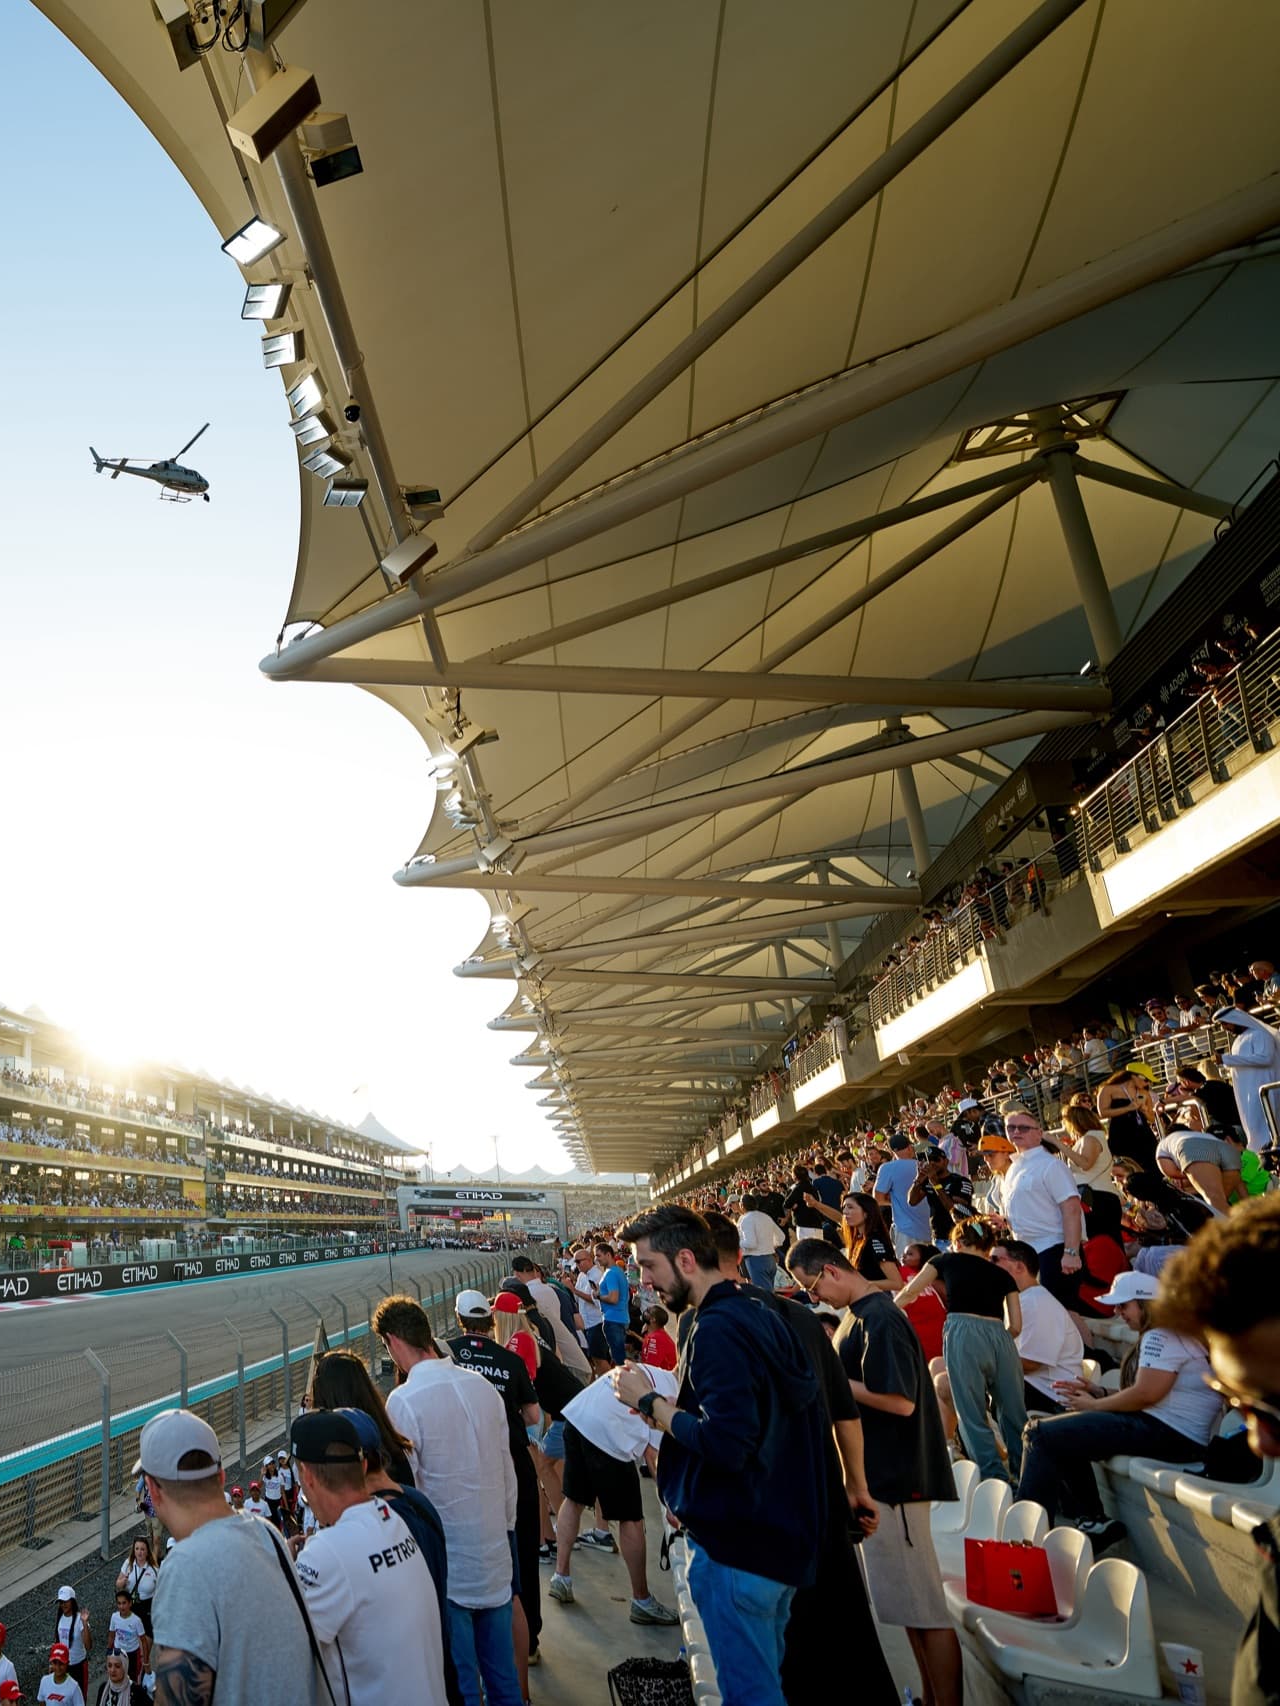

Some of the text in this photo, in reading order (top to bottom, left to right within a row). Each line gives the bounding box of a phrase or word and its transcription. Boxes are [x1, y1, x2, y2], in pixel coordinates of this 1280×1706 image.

[455, 1191, 503, 1200] ETIHAD
[250, 1254, 271, 1268] ETIHAD
[278, 1252, 297, 1265] ETIHAD
[303, 1250, 320, 1262] ETIHAD
[215, 1257, 240, 1273] ETIHAD
[56, 1270, 104, 1291] ETIHAD
[122, 1265, 158, 1283] ETIHAD
